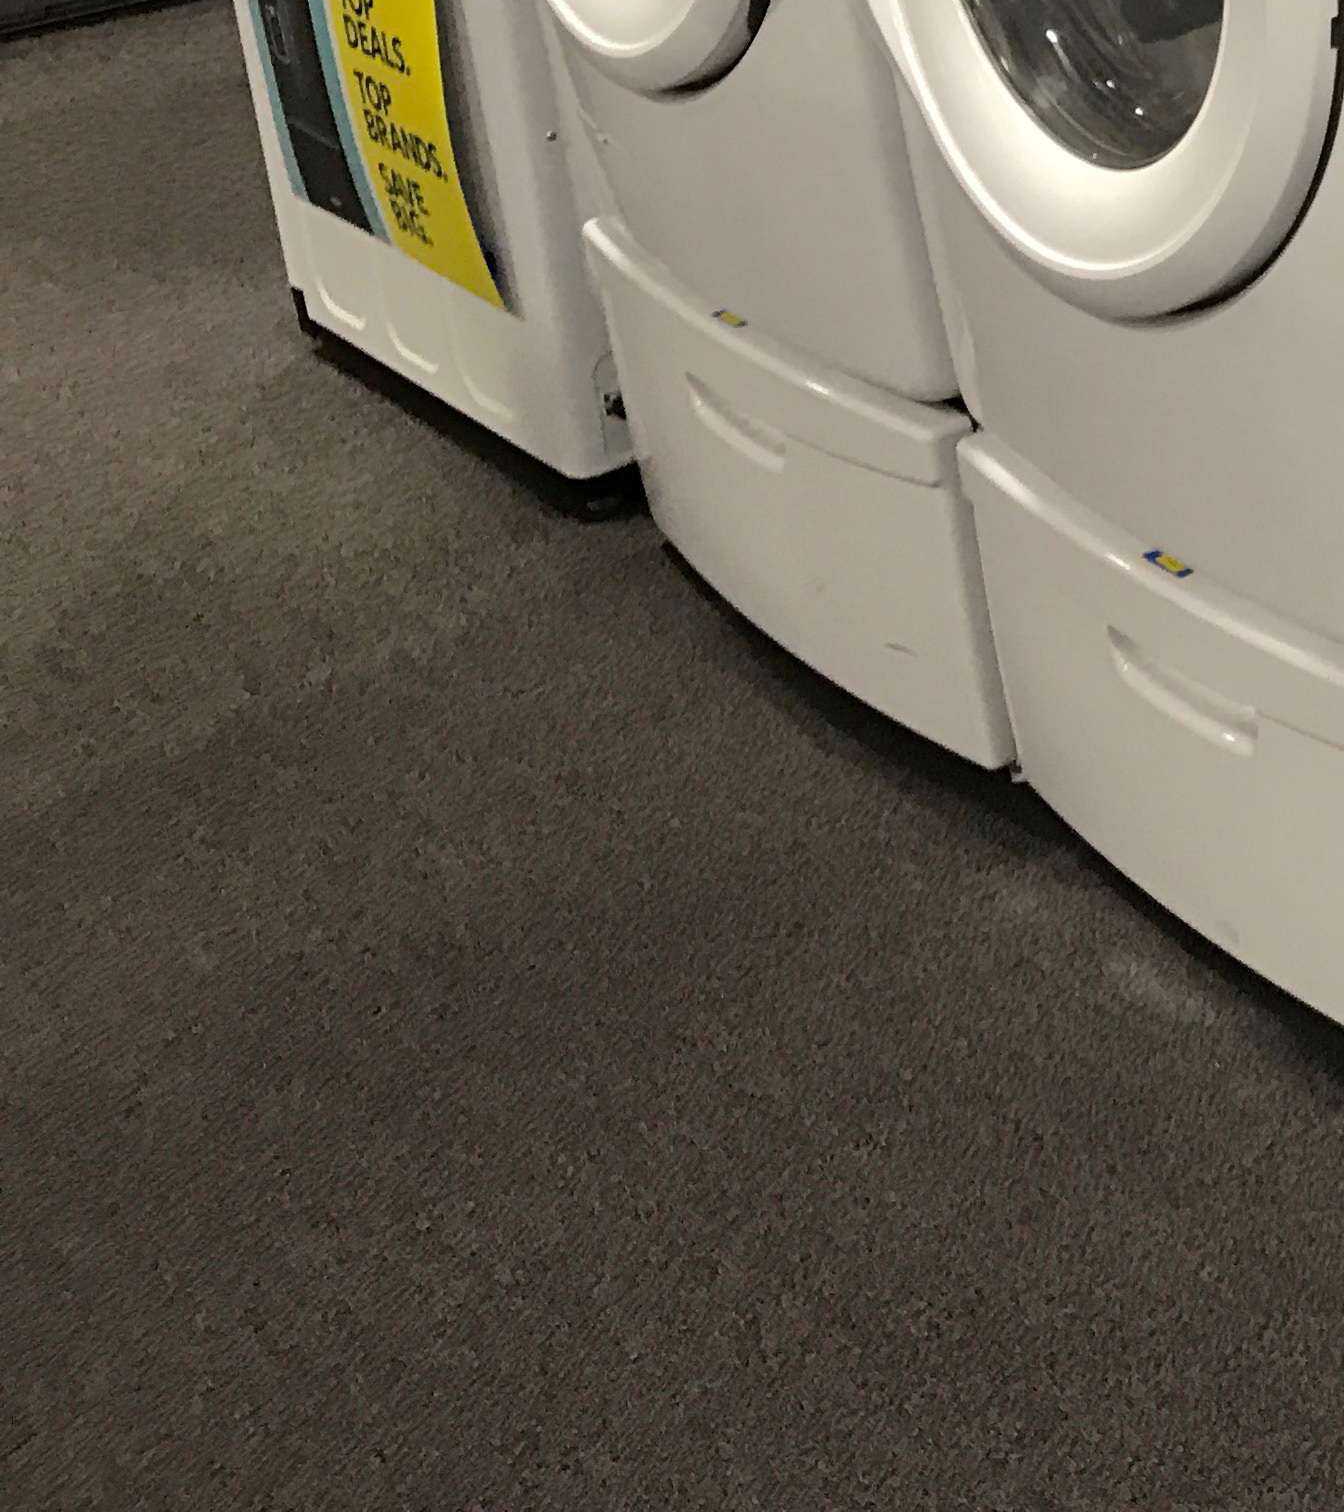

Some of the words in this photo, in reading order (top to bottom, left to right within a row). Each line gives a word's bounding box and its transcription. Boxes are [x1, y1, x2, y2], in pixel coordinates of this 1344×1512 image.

[342, 13, 411, 76] DEALS.
[353, 69, 392, 116] TOP
[363, 108, 448, 184] BRANDS.
[378, 161, 430, 217] SAVE
